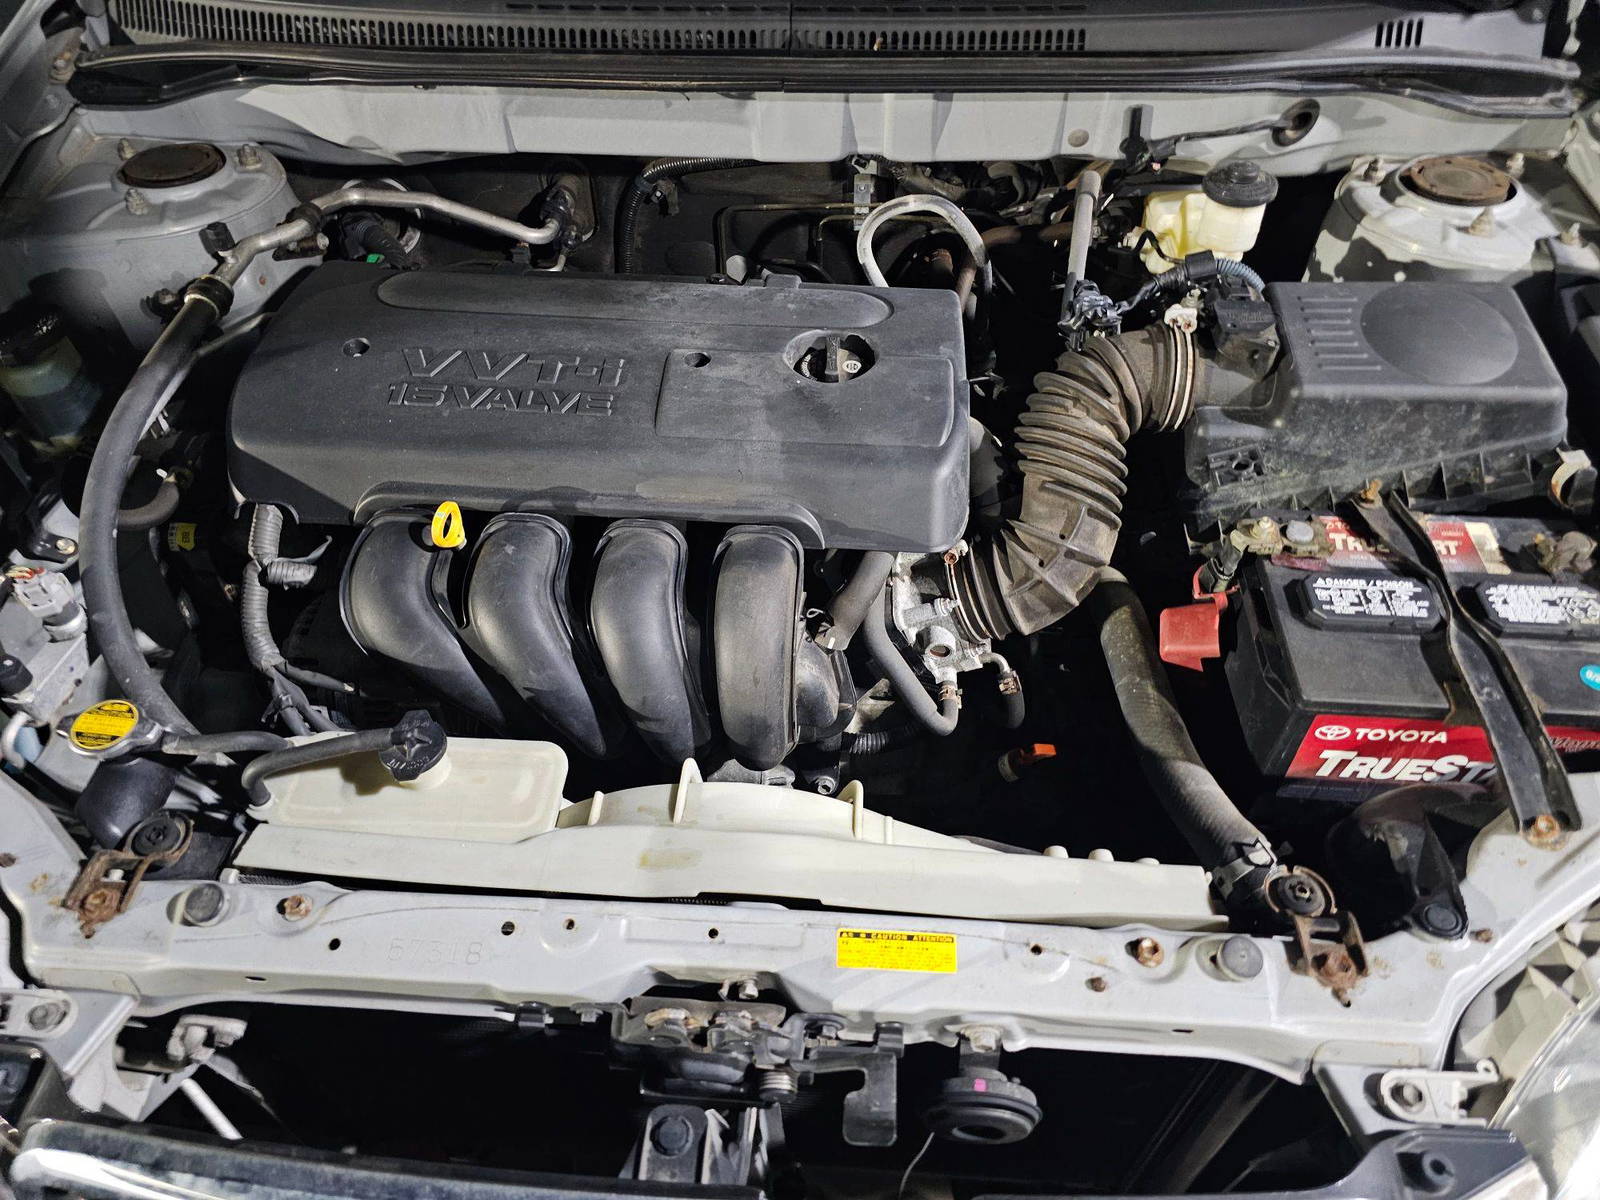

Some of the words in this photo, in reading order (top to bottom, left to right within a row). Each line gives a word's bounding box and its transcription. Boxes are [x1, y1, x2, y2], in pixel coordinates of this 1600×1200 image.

[1325, 577, 1367, 588] DANGER
[1375, 579, 1415, 590] POISON
[1355, 727, 1448, 744] TOYOTA
[871, 933, 908, 941] CAUTION
[912, 935, 953, 943] ATTENTION
